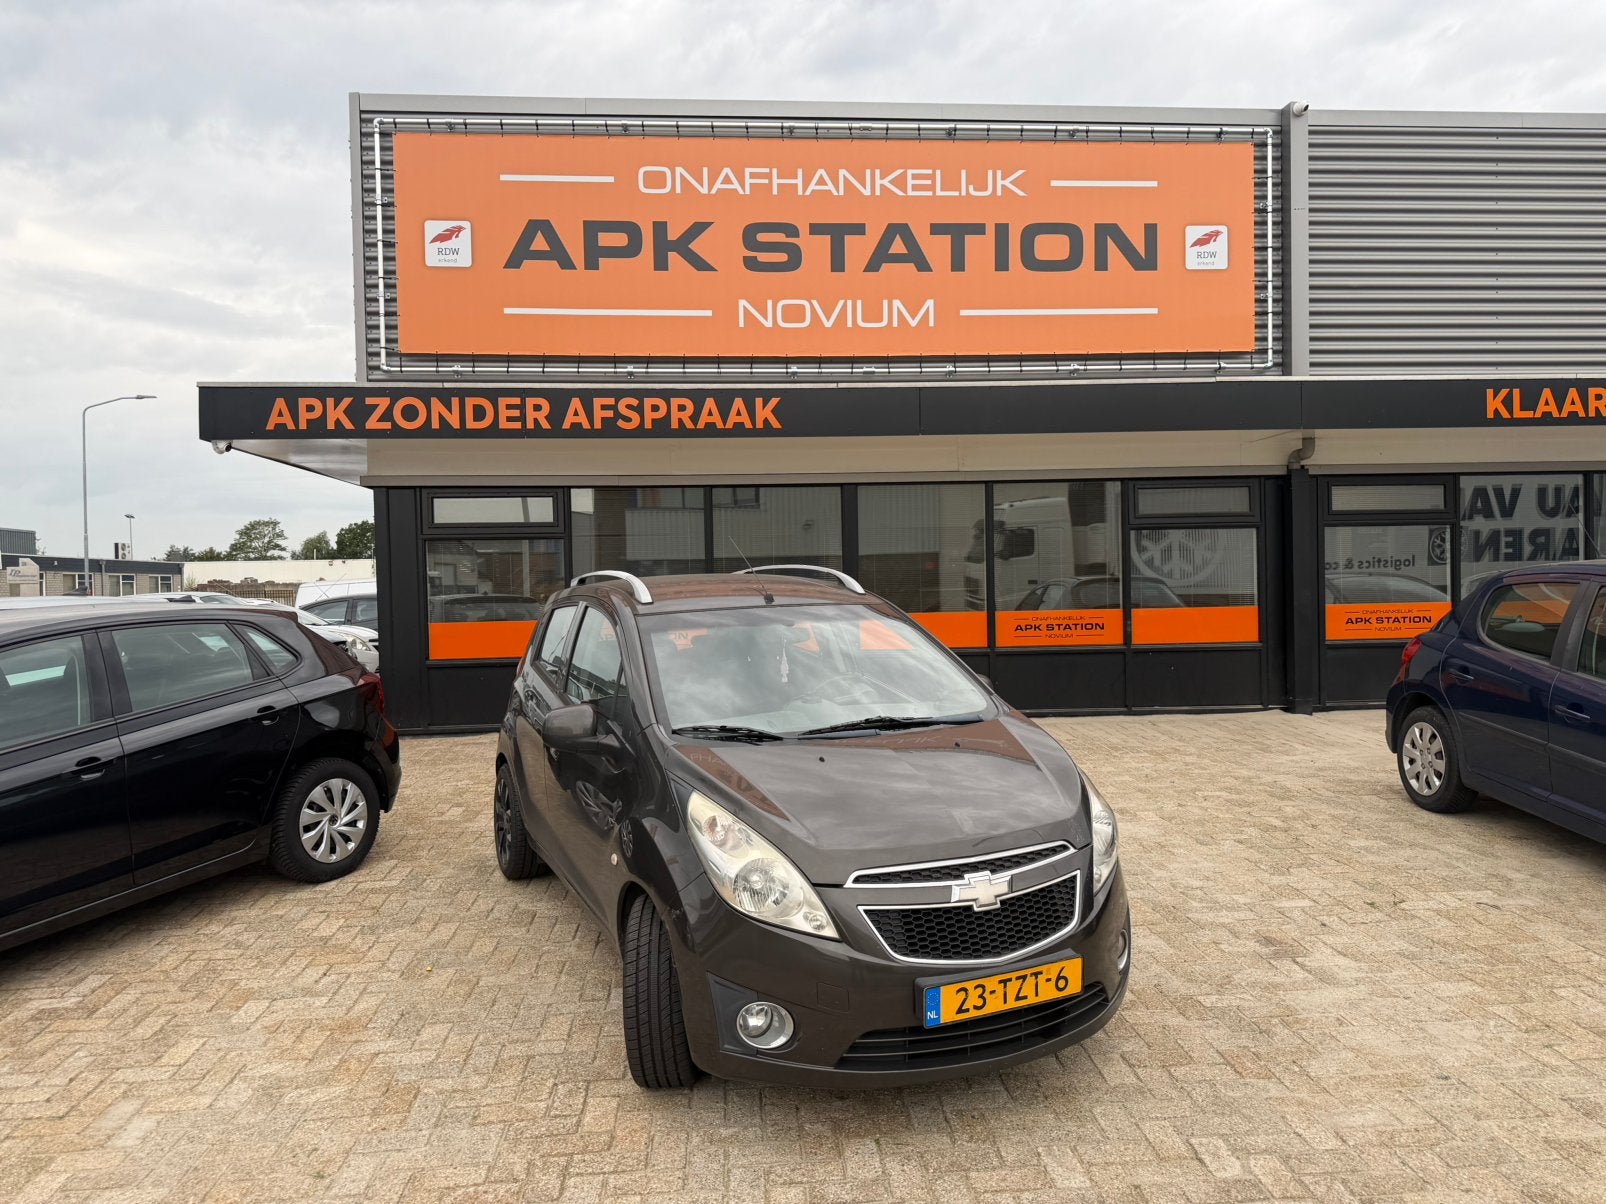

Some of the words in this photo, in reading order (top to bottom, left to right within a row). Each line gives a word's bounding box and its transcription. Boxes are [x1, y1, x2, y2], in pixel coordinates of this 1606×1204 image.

[637, 165, 1028, 197] ONAFHANKELIJK
[437, 247, 460, 256] RDW
[502, 218, 719, 272] APK
[741, 221, 1159, 273] STATION
[1196, 250, 1217, 259] RDW
[738, 298, 935, 329] NOVIUM
[265, 396, 356, 431] APK
[364, 396, 551, 431] ZONDER
[561, 396, 782, 431] AFSPRAAK
[1486, 387, 1606, 419] KLAAR
[1014, 623, 1043, 632] APK
[1045, 622, 1105, 632] STATION
[1345, 617, 1373, 625] APK
[1375, 615, 1432, 624] STATION
[954, 966, 1069, 1016] 23-TZT-6
[927, 1010, 939, 1020] NL
